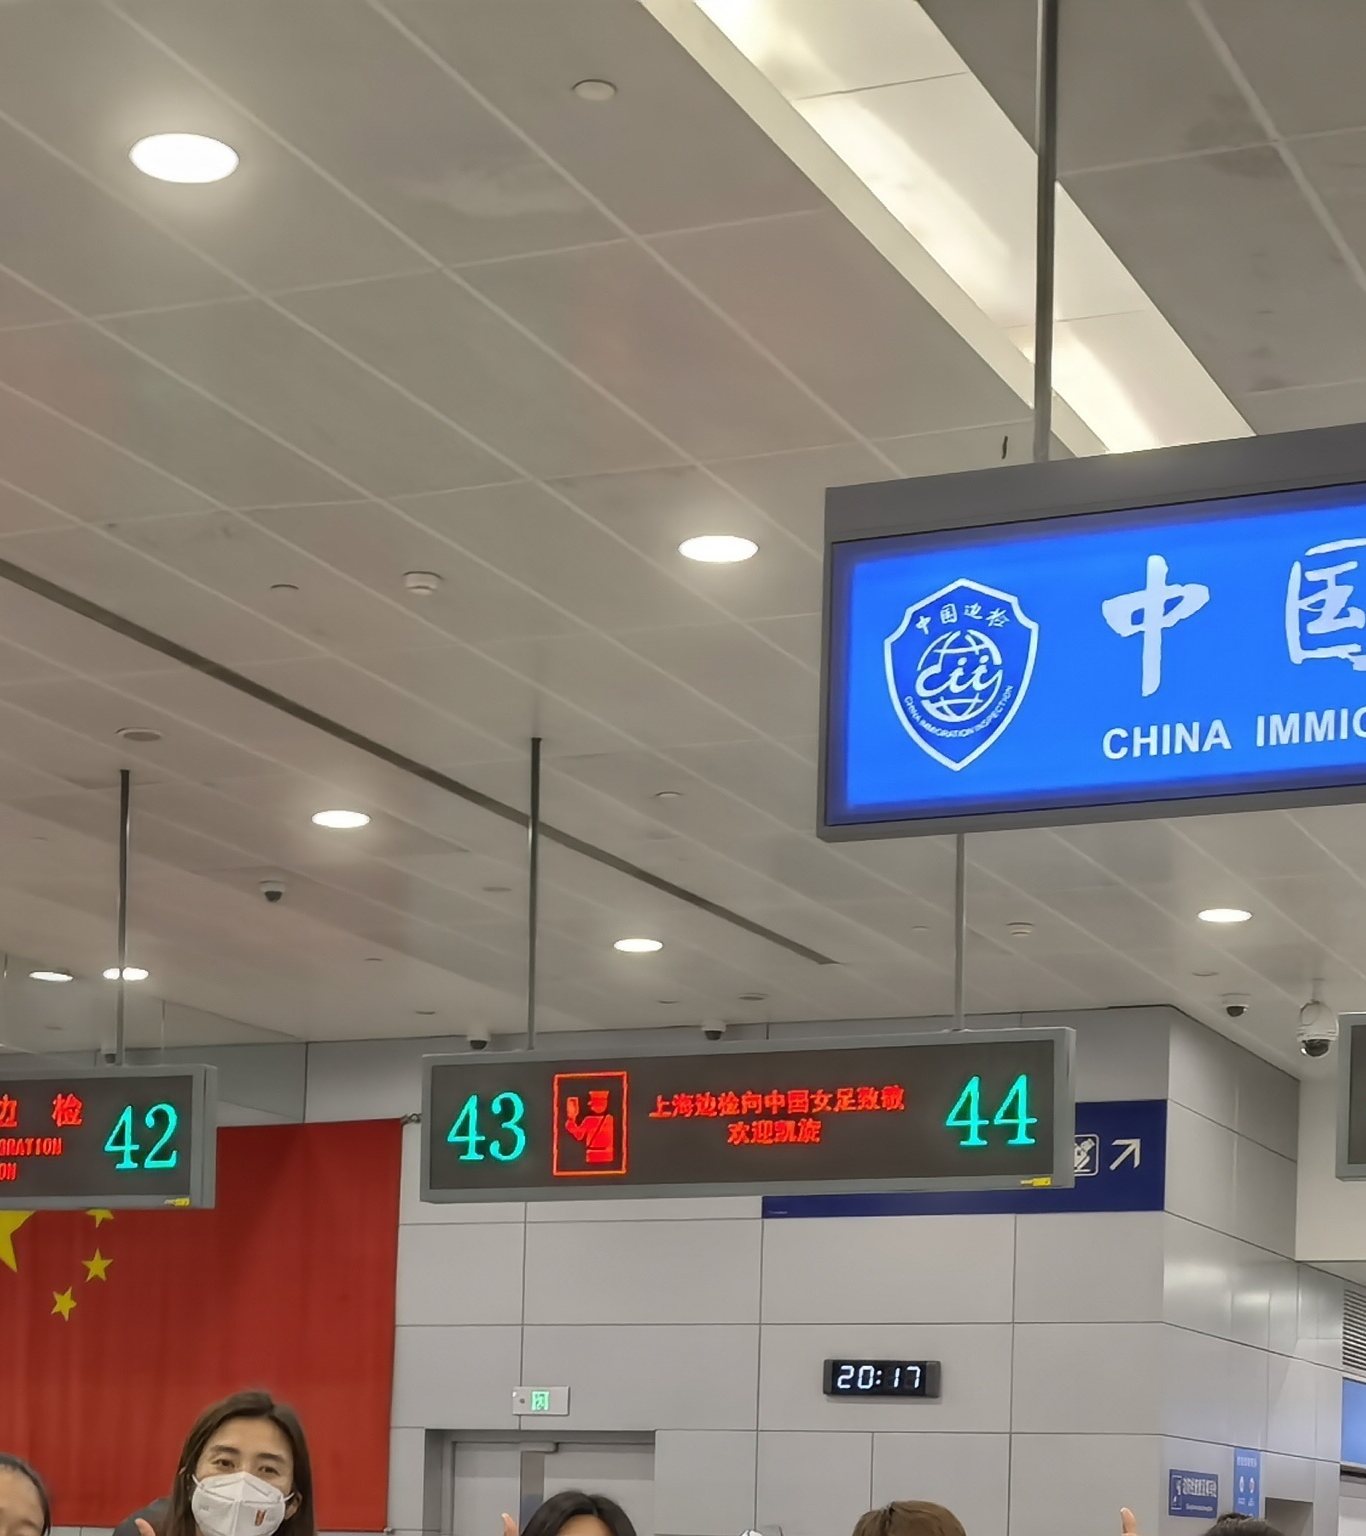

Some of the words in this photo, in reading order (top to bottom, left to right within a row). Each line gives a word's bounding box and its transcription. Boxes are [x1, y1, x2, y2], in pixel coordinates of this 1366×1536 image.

[915, 602, 1011, 635] 中国边检
[1102, 717, 1232, 761] CHINA
[649, 1084, 906, 1119] 上海边检向中国女足致敬
[946, 1074, 1038, 1146] 44
[104, 1102, 178, 1170] 42
[446, 1091, 526, 1162] 43
[727, 1117, 822, 1146] 欢迎凯旋
[836, 1364, 923, 1392] 20:17
